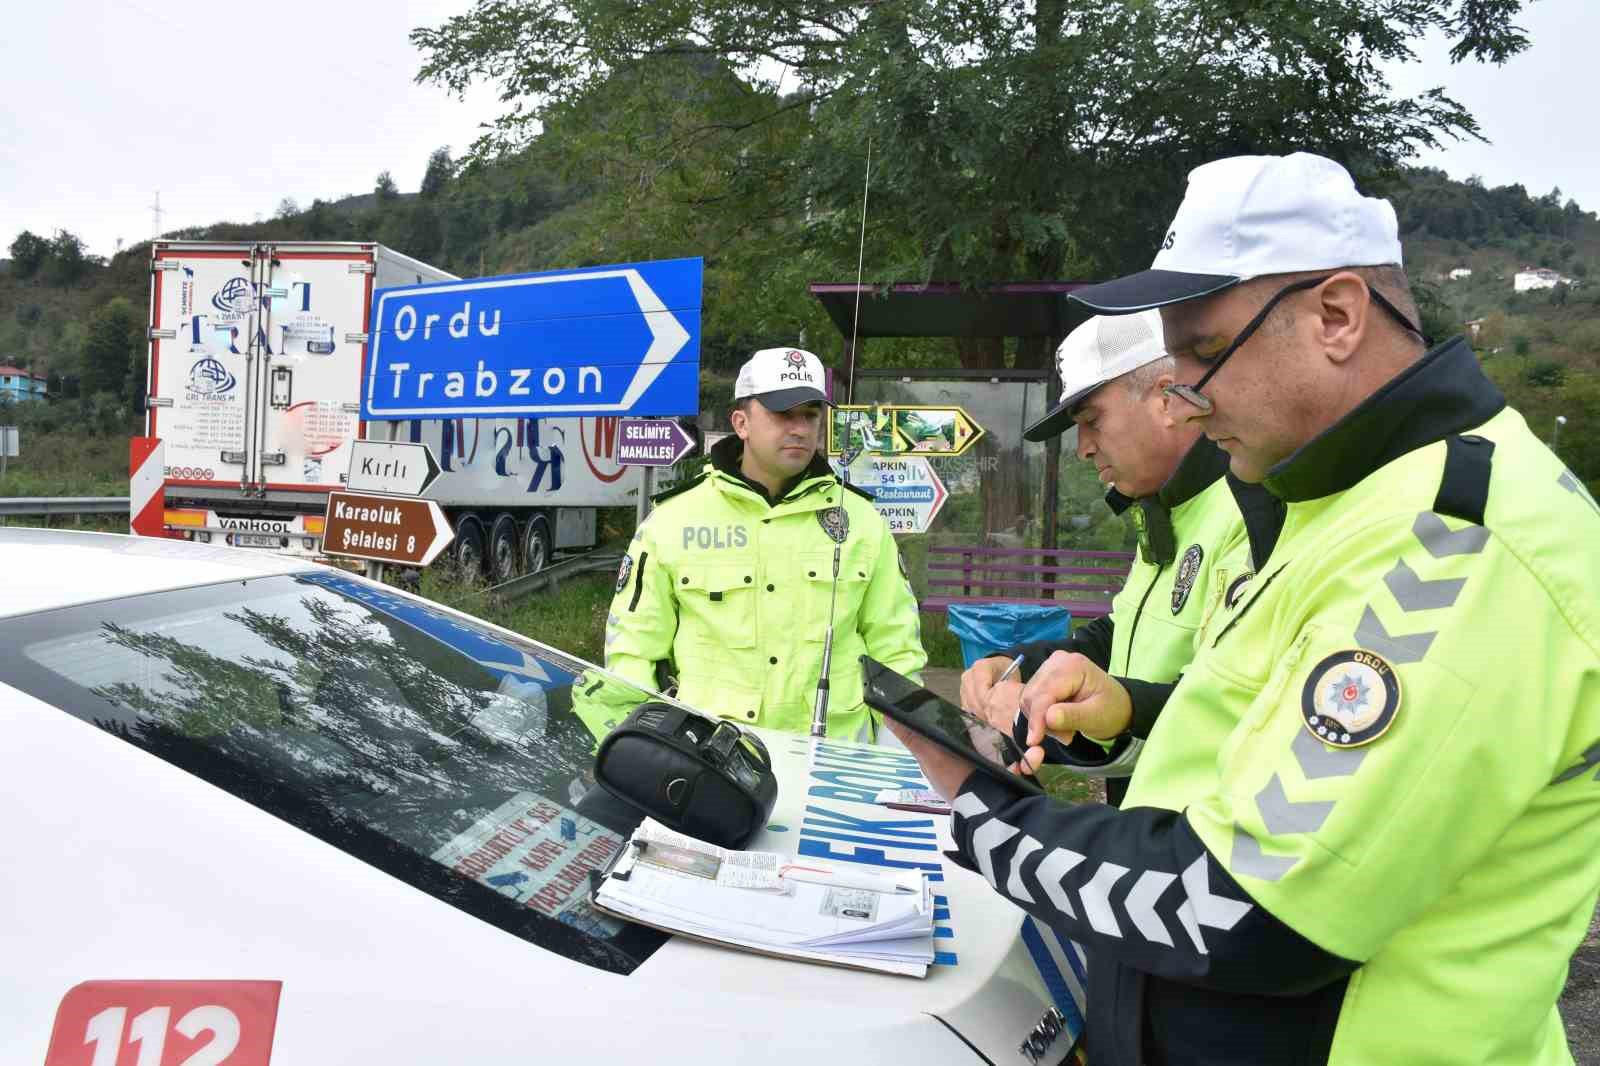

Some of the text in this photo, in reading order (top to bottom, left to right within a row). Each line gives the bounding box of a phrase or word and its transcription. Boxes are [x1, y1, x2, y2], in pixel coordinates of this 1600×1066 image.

[394, 301, 501, 341] Ordu
[389, 360, 603, 398] Trabzon
[780, 371, 814, 383] POLİS
[626, 423, 671, 439] SELİMİYE
[620, 443, 675, 459] MAHALLESİ
[361, 457, 407, 478] Kırlı
[876, 487, 932, 500] Restaurant
[335, 501, 402, 525] Karaoluk
[219, 519, 291, 534] VANHOOL
[682, 524, 748, 550] POLİS
[343, 528, 416, 554] Şelalesi 8
[1353, 652, 1390, 676] ORDU
[84, 1005, 241, 1066] 112
